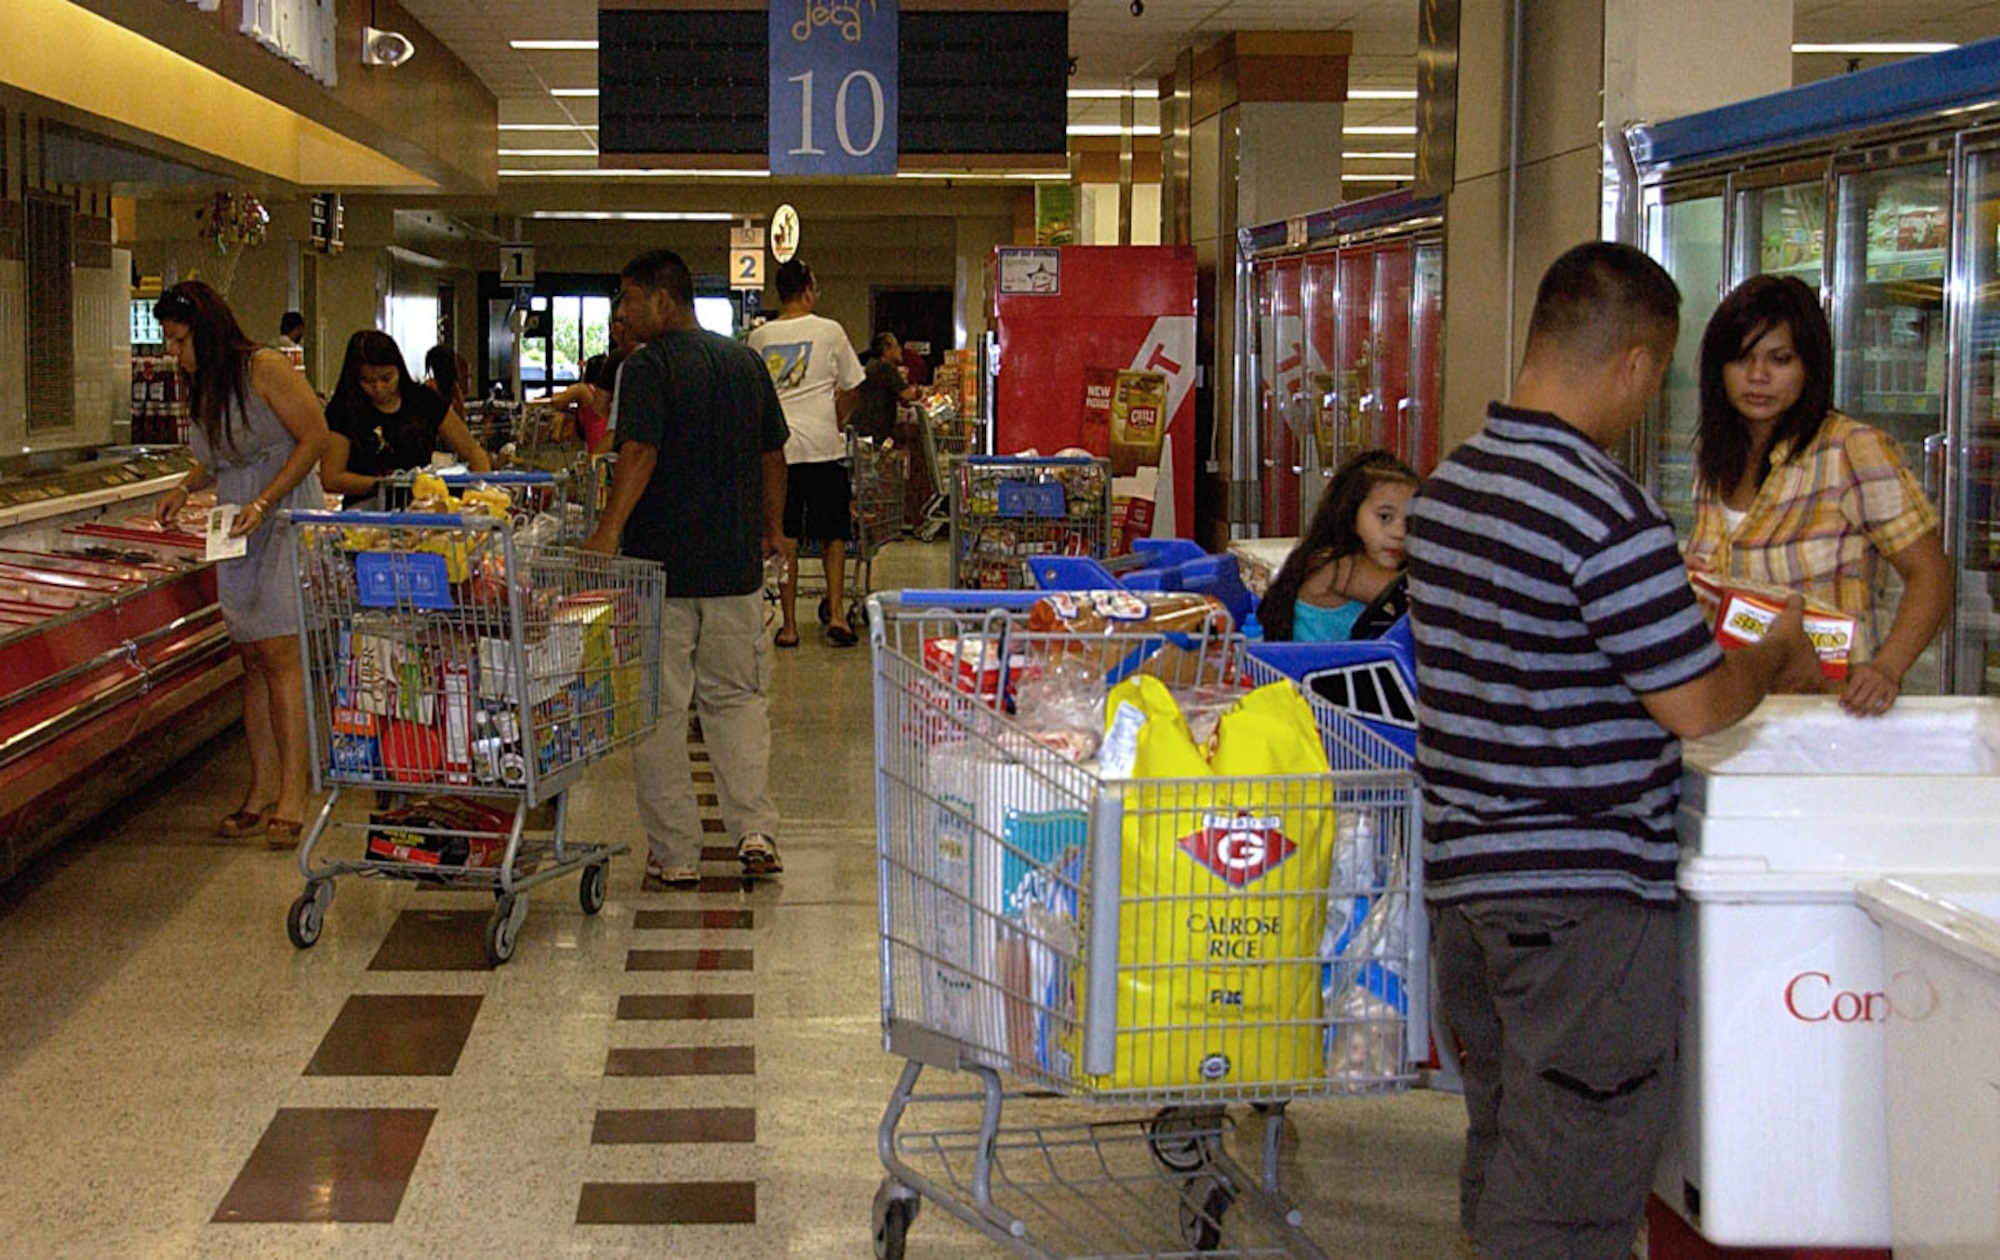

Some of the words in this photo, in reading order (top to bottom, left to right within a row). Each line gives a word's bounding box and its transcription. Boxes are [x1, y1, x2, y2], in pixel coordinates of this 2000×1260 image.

[787, 70, 884, 157] 10
[512, 253, 522, 276] 1
[739, 255, 756, 279] 2
[1217, 831, 1266, 869] G
[1209, 940, 1258, 959] RICE
